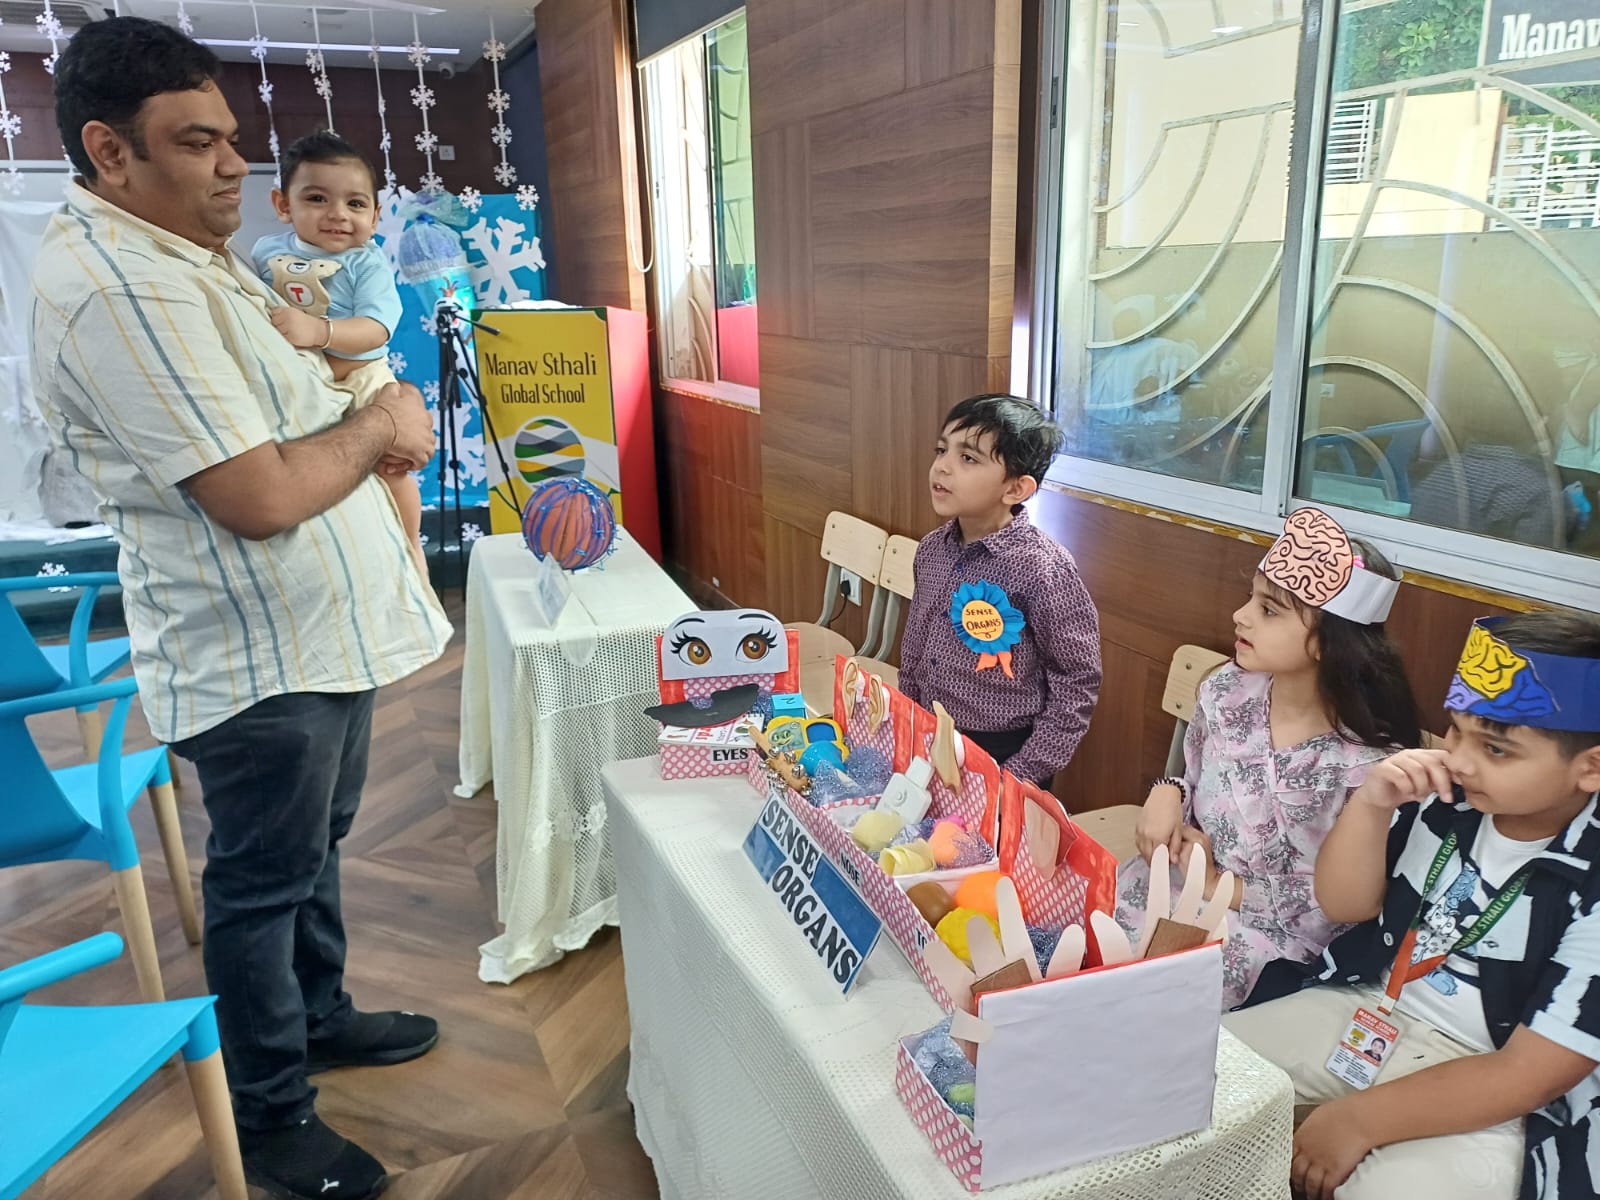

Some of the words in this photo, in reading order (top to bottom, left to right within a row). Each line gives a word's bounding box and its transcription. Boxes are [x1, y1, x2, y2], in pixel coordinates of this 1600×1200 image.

[290, 287, 304, 303] T
[485, 352, 538, 376] Manav
[543, 352, 597, 376] Sthali
[501, 383, 539, 404] Global
[542, 383, 585, 404] School
[966, 608, 993, 616] SENSE
[966, 618, 1001, 631] ORGANS
[713, 748, 748, 761] EYES
[762, 799, 822, 880] SENSE
[841, 853, 860, 888] NOSE
[1427, 855, 1447, 884] STHALI
[772, 864, 858, 985] ORGANS
[1478, 901, 1505, 930] STHALI
